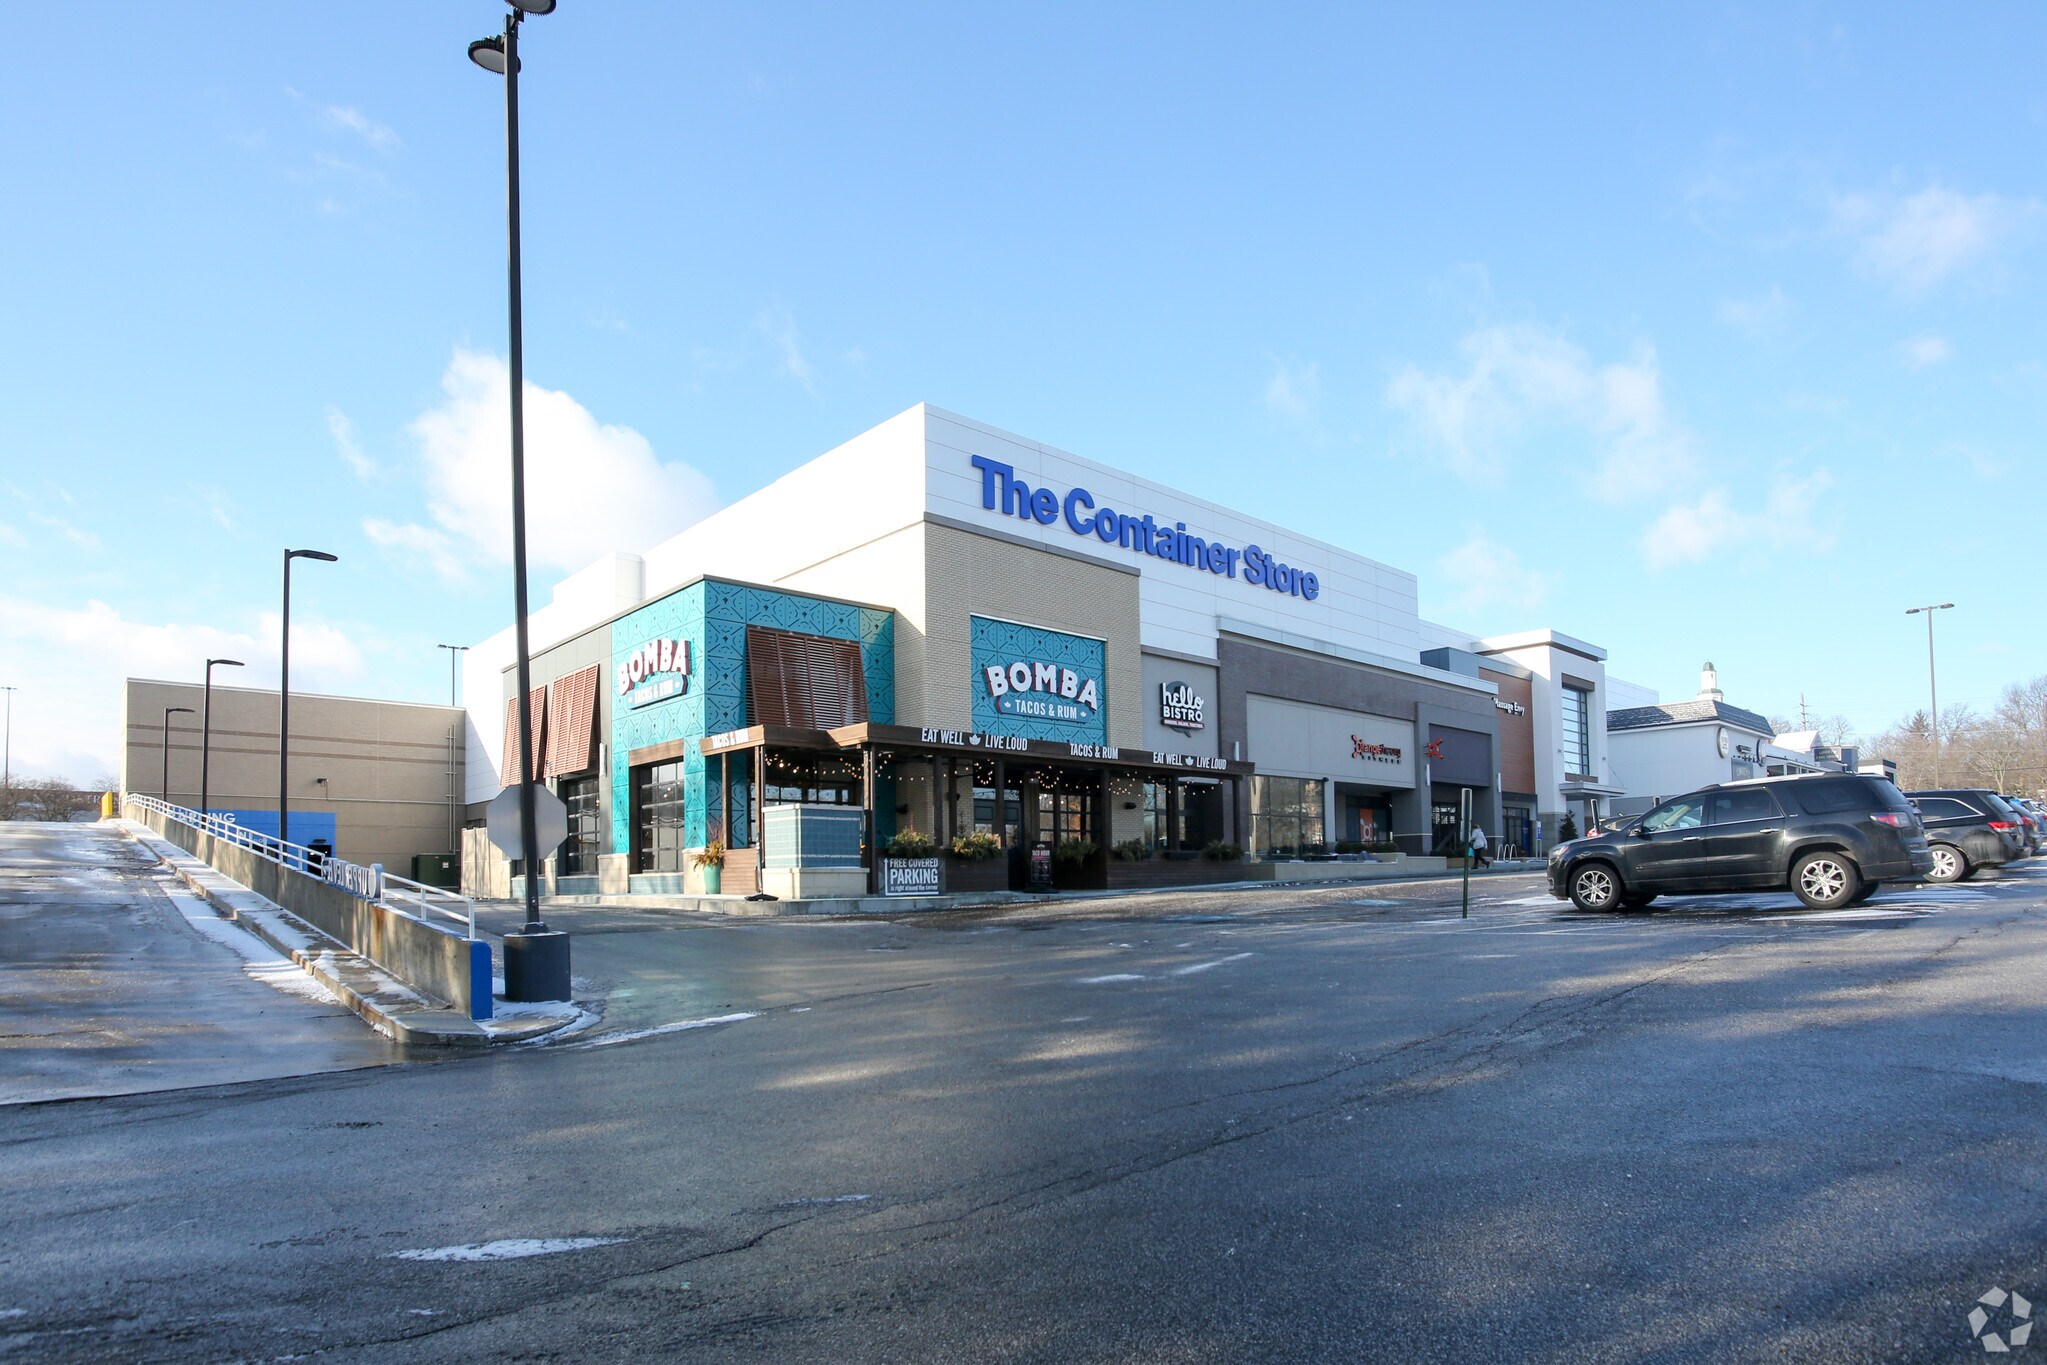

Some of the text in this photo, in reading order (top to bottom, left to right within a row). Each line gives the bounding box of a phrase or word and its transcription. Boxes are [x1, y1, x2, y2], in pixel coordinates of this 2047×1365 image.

[972, 455, 1320, 600] The Container Store
[617, 638, 690, 696] BOMBA
[986, 662, 1097, 711] BOMBA
[1163, 682, 1204, 710] hello
[1015, 699, 1077, 719] TACOS & RUM
[1163, 706, 1203, 722] BISTRO
[921, 728, 1028, 751] EAT WELL LIVE LOUD
[1070, 743, 1118, 760] TACOS & RUM
[1153, 752, 1227, 770] EAT WELL LIVE LOUD
[890, 858, 939, 868] FREE COVERED
[890, 868, 939, 885] PARKING
